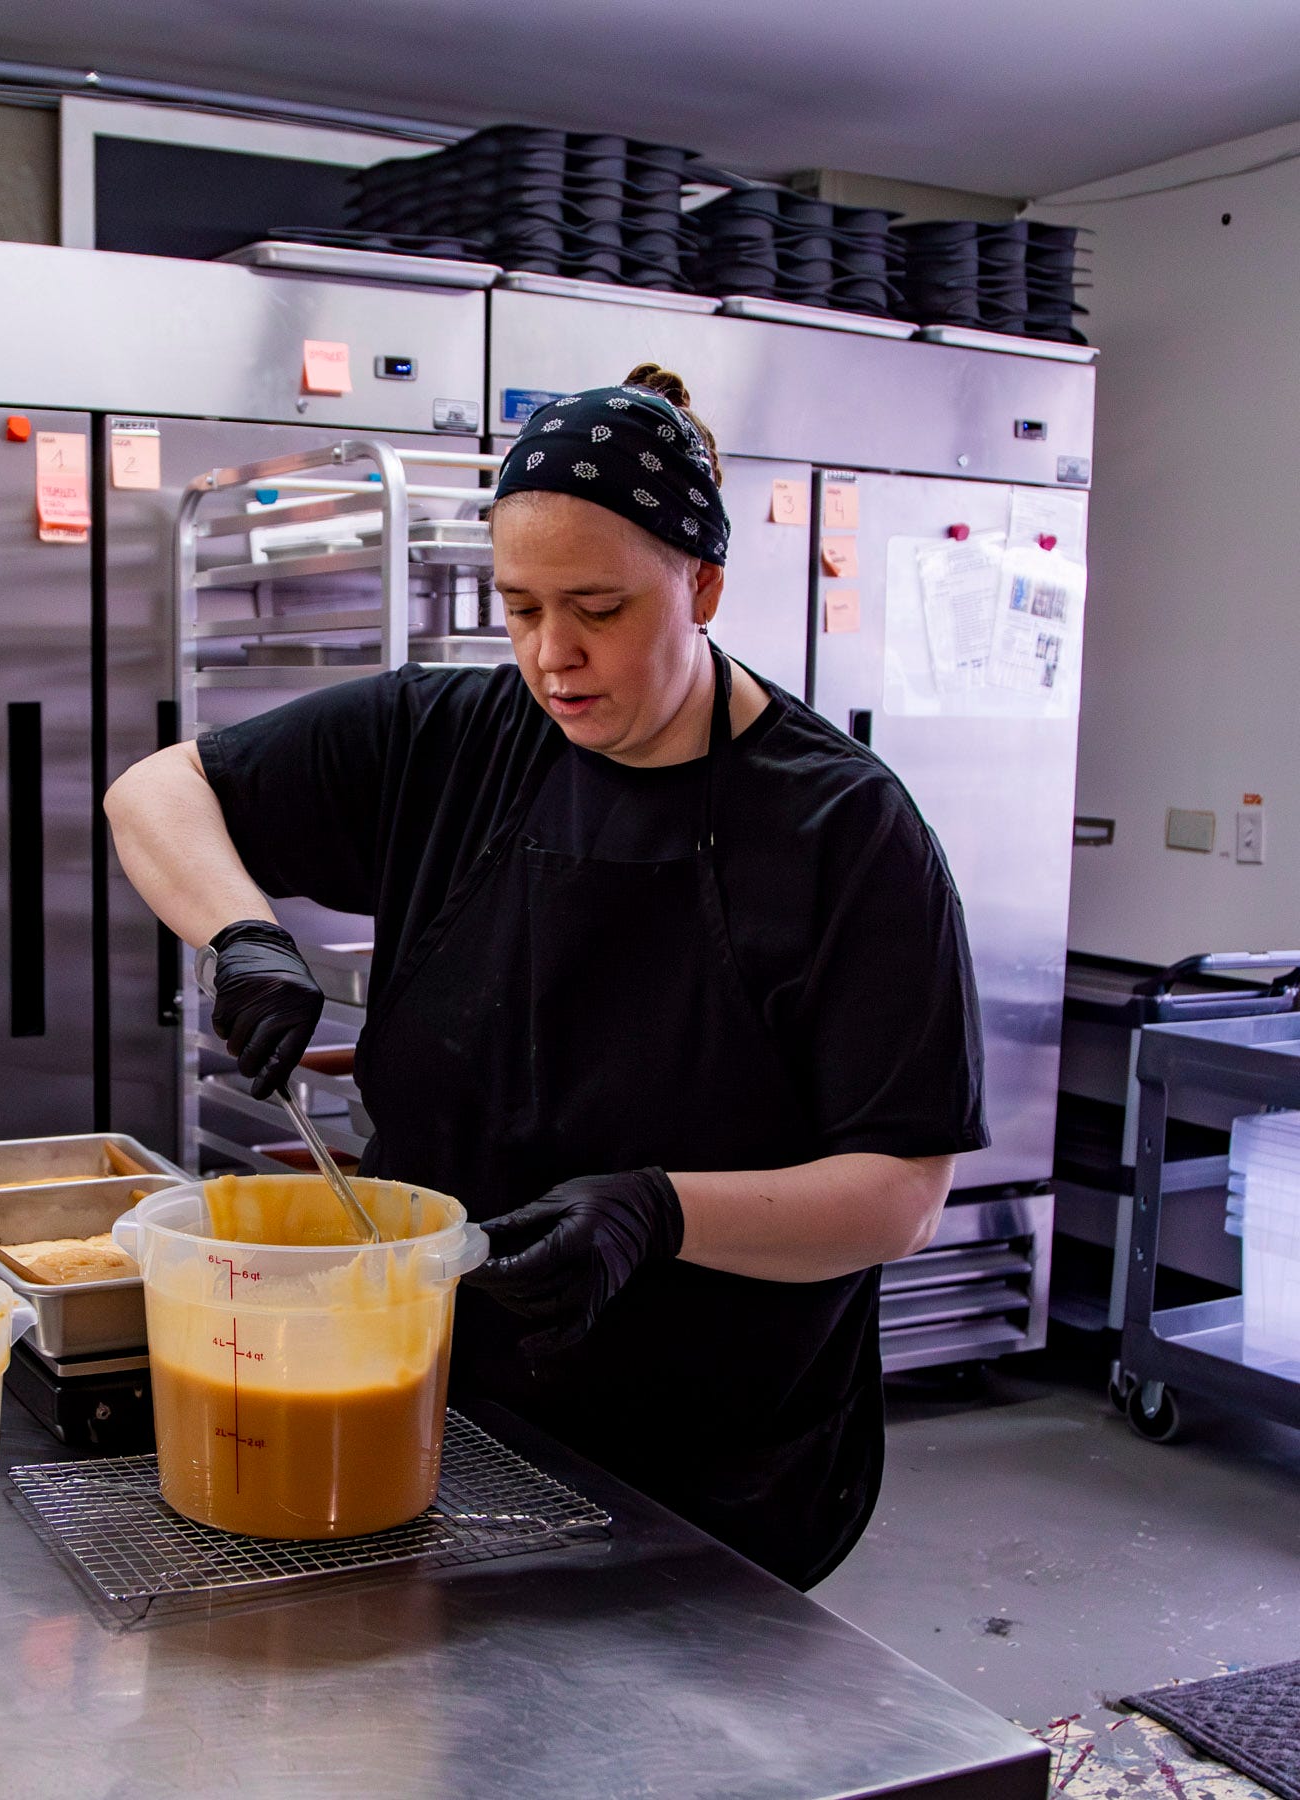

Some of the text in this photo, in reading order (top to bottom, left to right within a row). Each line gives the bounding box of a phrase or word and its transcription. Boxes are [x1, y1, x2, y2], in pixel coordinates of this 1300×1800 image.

[123, 456, 140, 473] 2
[783, 494, 796, 515] 3
[834, 500, 845, 521] 4
